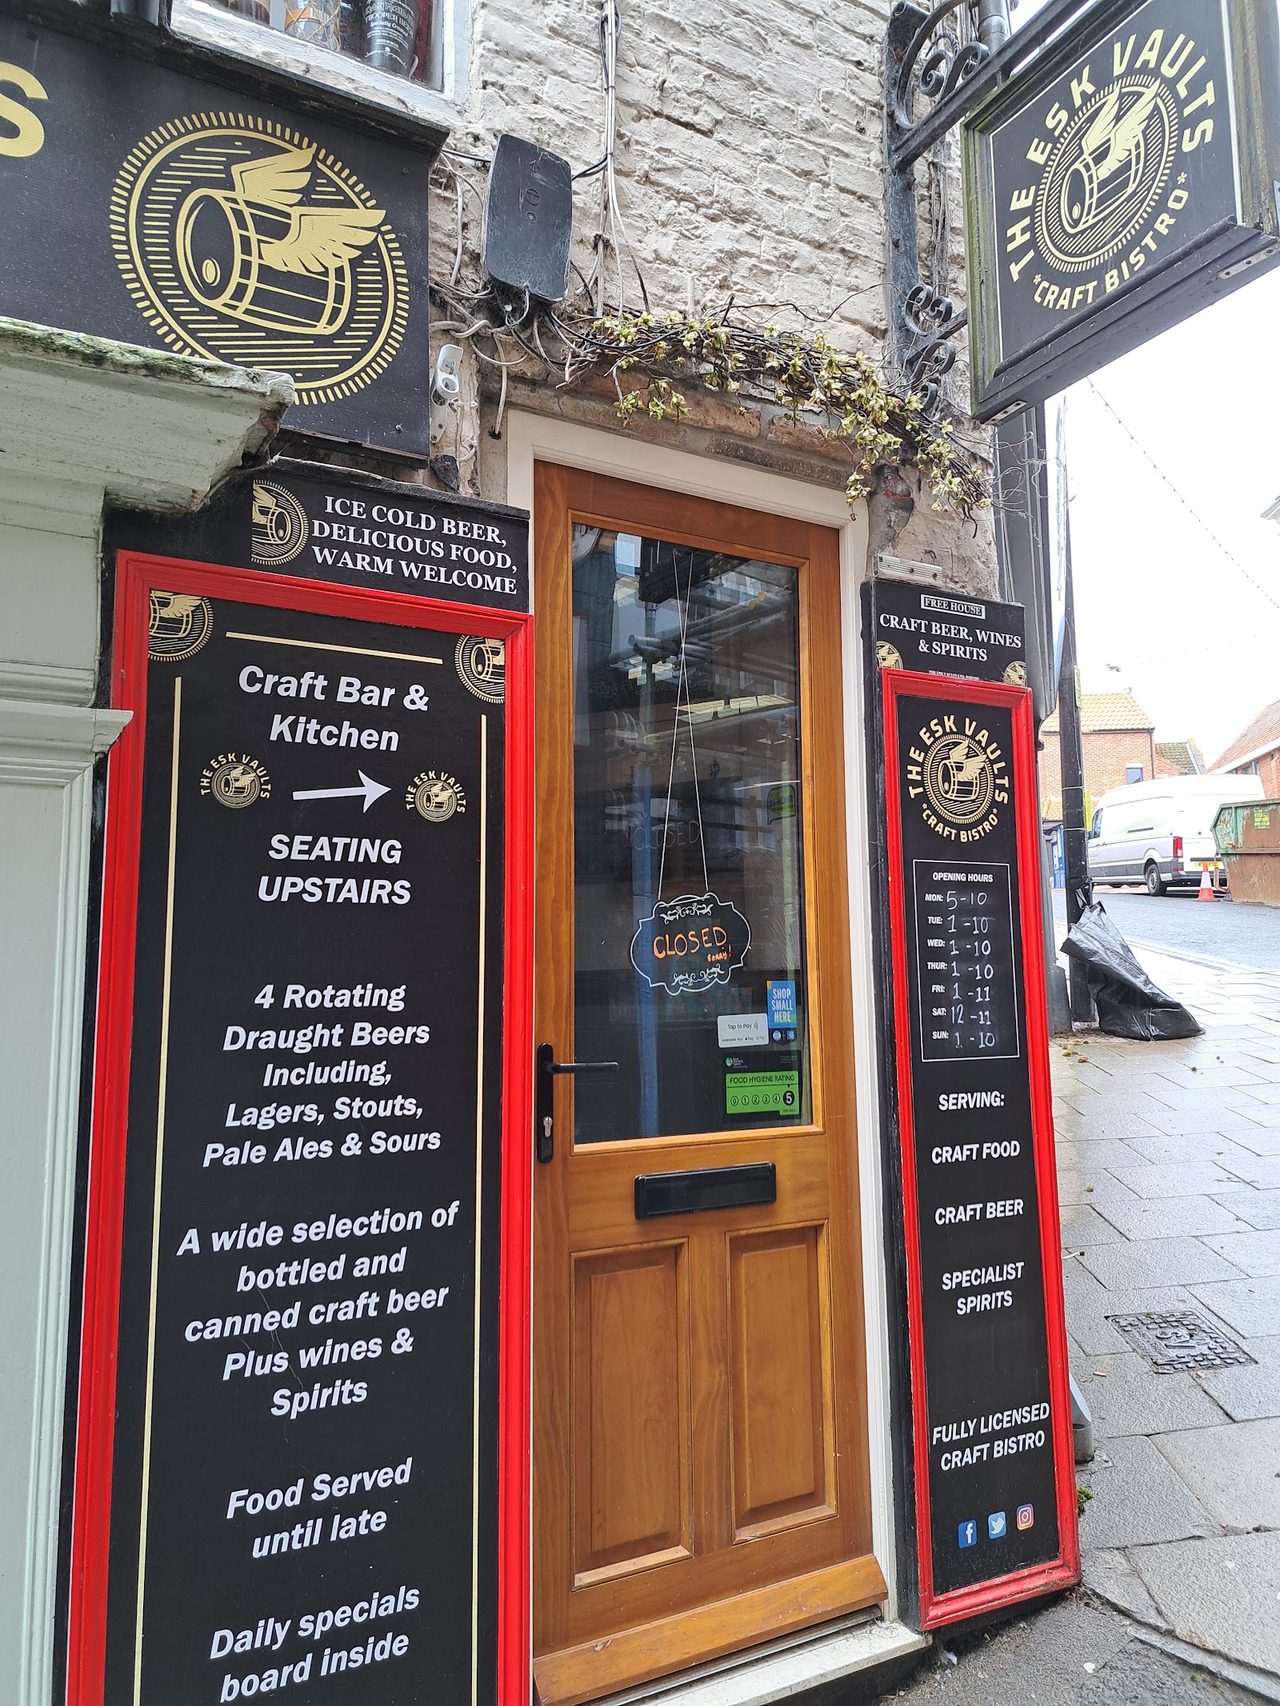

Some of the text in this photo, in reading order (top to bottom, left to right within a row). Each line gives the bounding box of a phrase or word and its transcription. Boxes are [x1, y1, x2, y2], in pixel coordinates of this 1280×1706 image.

[1006, 28, 1216, 283] THE ESK VAULTS
[1034, 189, 1190, 311] CRAFT BISTRO
[325, 495, 507, 547] ICE COLD BEER,
[311, 519, 518, 574] DELICIOUS FOOD,
[311, 545, 517, 595] WARM WELCOME
[924, 597, 982, 616] FREE HOUSE
[880, 613, 1022, 649] CRAFT BEER, WINES
[918, 639, 988, 662] & SPIRITS
[238, 665, 430, 711] Craft Bar &
[269, 714, 399, 752] Kitchen
[200, 752, 272, 799] THE ESK VAULTS
[907, 715, 1009, 804] THE ESK VAULTS
[405, 770, 467, 814] THE ESK VAULTS
[922, 809, 998, 842] CRAFT BISTRO
[268, 833, 402, 865] SEATING
[258, 875, 412, 905] UPSTAIRS
[933, 872, 994, 883] OPENING HOURS
[925, 893, 943, 902] MON:
[927, 916, 943, 925] TUE:
[653, 926, 727, 959] CLOSED
[927, 939, 945, 948] WED:
[927, 961, 948, 970] THUR:
[255, 982, 406, 1012] 4 Rotating
[771, 1000, 793, 1011] SMALL
[772, 988, 791, 999] SHOP
[931, 985, 946, 993] FRI:
[774, 1011, 791, 1022] HERE
[932, 1007, 947, 1016] SAT:
[223, 1021, 430, 1054] Draught Beers
[932, 1031, 949, 1040] SUN:
[263, 1060, 392, 1087] Including,
[749, 1075, 773, 1083] HYGIENE
[774, 1074, 795, 1082] RATING
[225, 1094, 423, 1130] Lagers, Stouts,
[785, 1092, 793, 1104] 5
[938, 1090, 1005, 1111] SERVING:
[202, 1130, 442, 1168] Pale Ales & Sours
[931, 1140, 1020, 1164] CRAFT FOOD
[935, 1199, 1024, 1225] CRAFT BEER
[176, 1201, 460, 1257] A wide selection of
[236, 1246, 408, 1292] bottled and
[941, 1261, 1024, 1290] SPECIALIST
[184, 1284, 450, 1343] canned craft beer
[957, 1290, 1012, 1315] SPIRITS
[222, 1327, 415, 1381] Plus wines &
[270, 1379, 369, 1420] Spirits
[933, 1402, 1050, 1445] FULLY LICENSED
[940, 1430, 1045, 1471] CRAFT BISTRO
[226, 1457, 413, 1520] Food Served
[251, 1510, 388, 1559] until late
[209, 1584, 421, 1660] Daily specials
[220, 1631, 410, 1704] board inside
